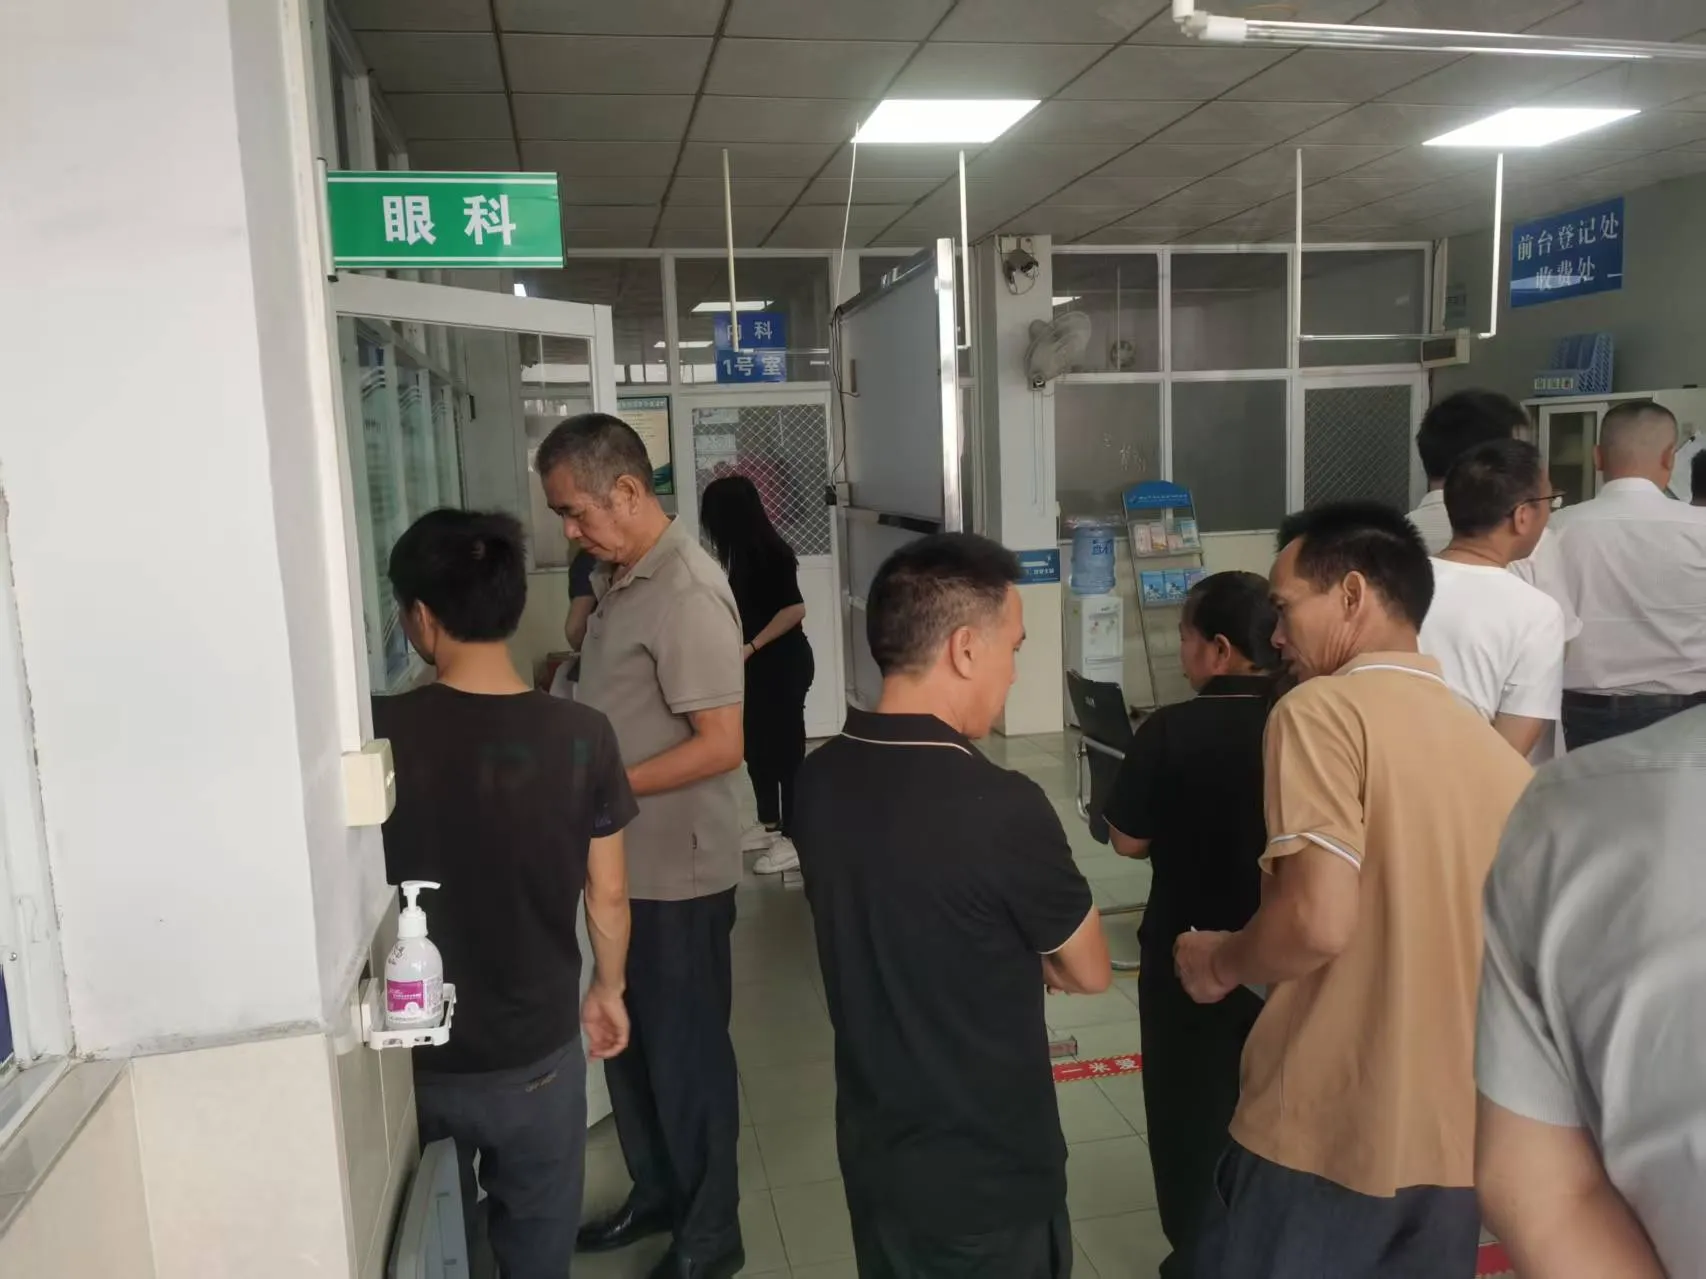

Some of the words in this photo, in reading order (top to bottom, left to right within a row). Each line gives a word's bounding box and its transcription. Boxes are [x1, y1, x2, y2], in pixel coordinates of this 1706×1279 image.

[383, 195, 516, 245] 眼科
[1518, 212, 1619, 261] 前台登记处
[1536, 256, 1595, 290] 收费处
[723, 356, 781, 376] 1号室
